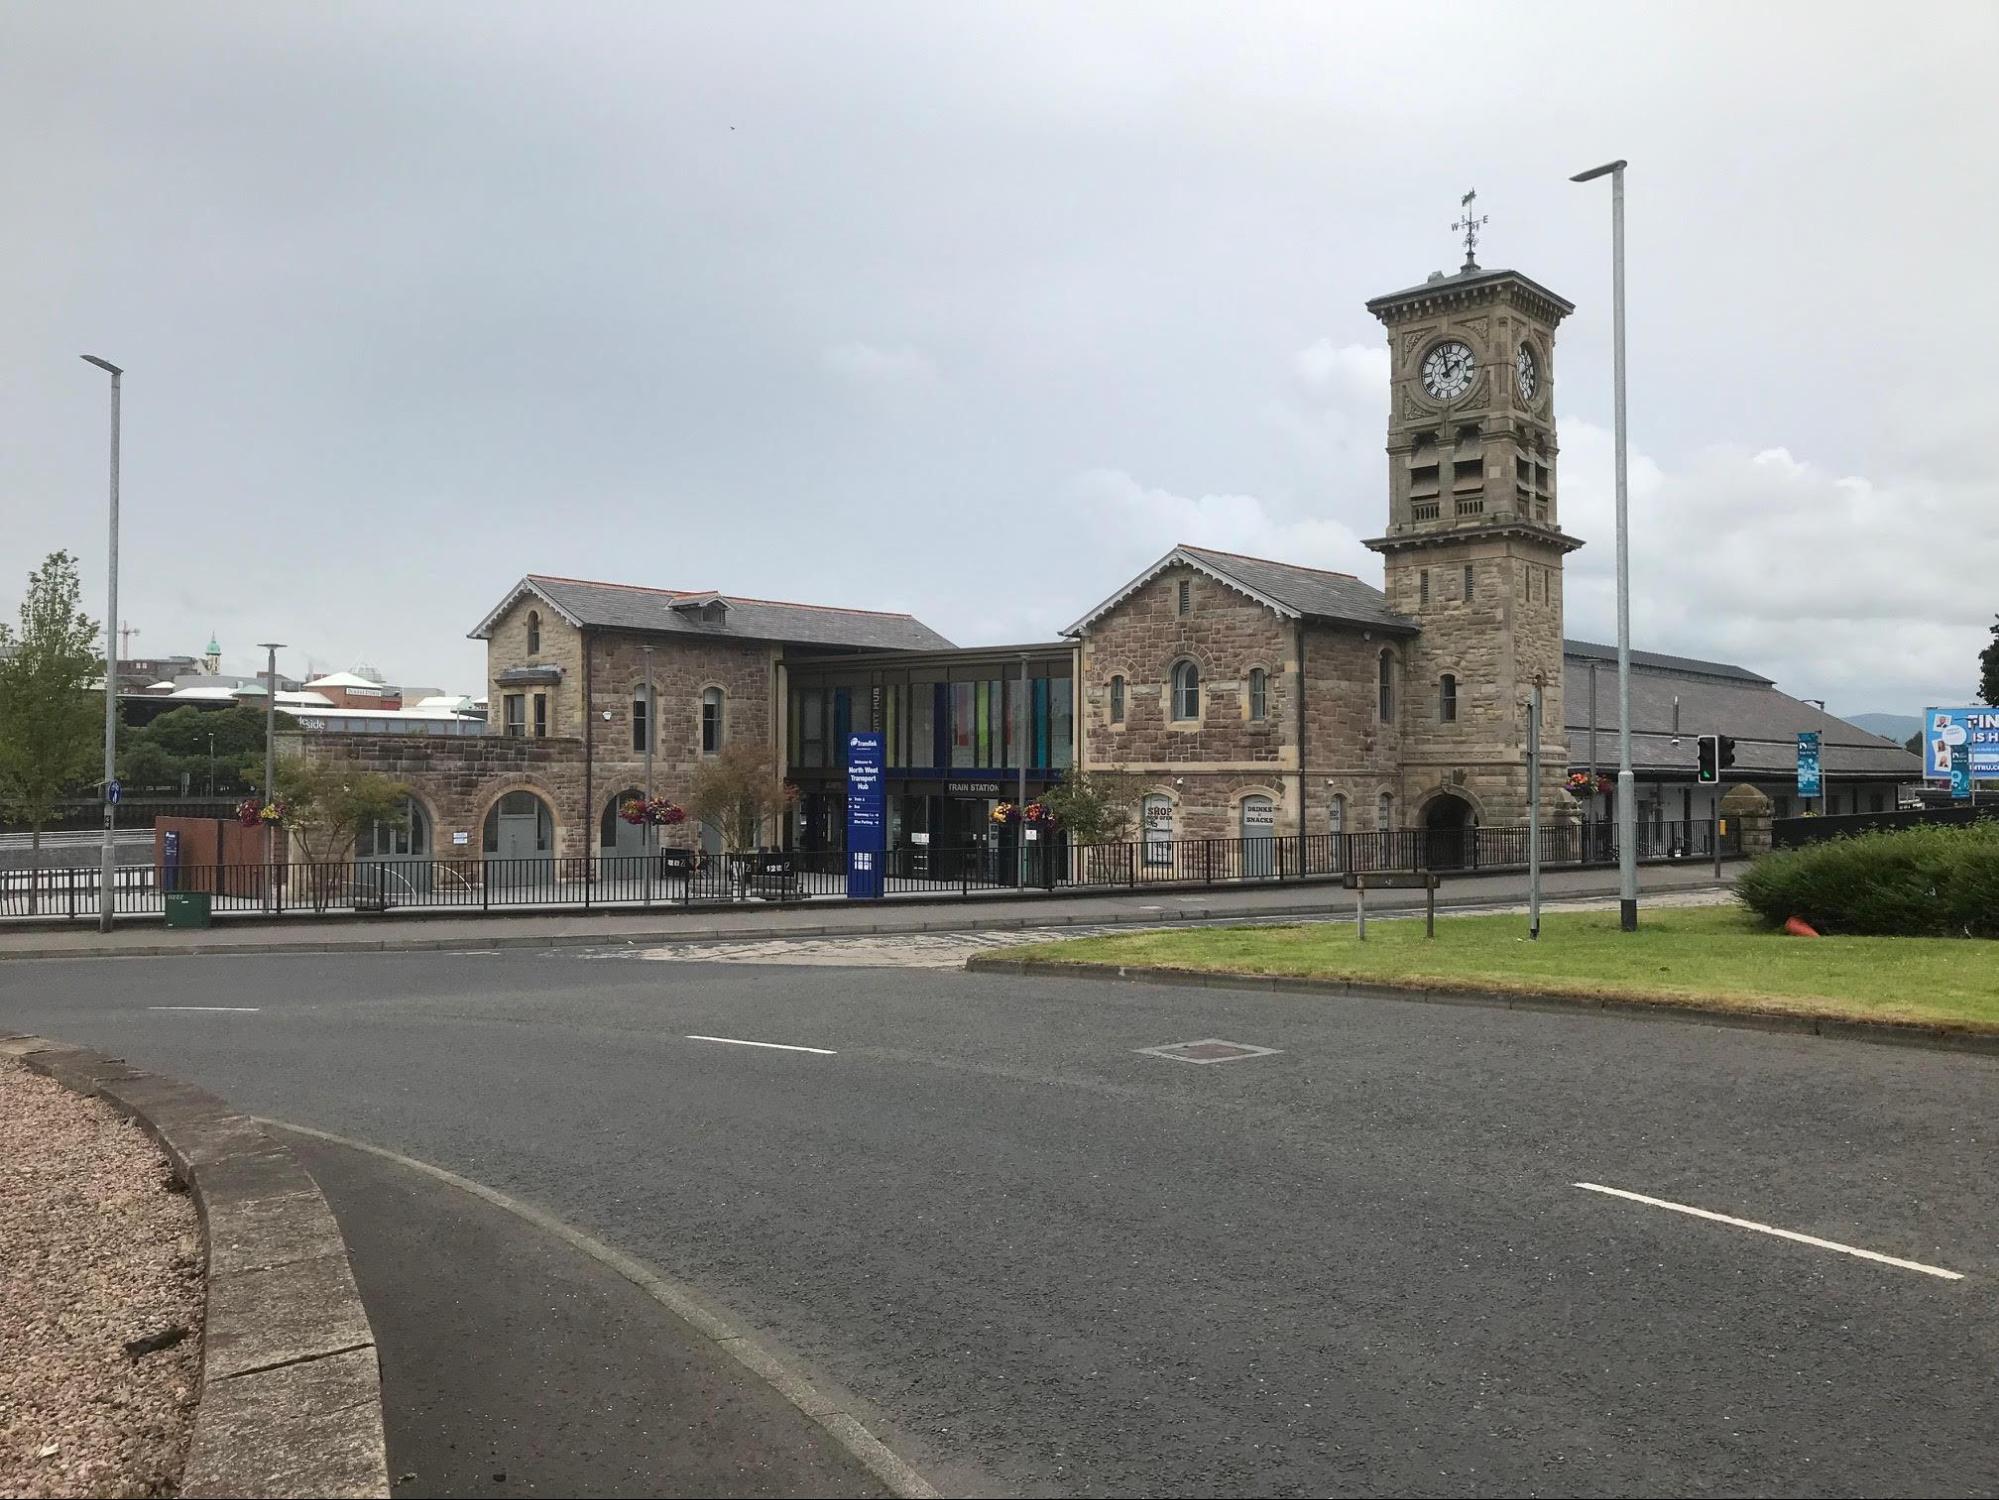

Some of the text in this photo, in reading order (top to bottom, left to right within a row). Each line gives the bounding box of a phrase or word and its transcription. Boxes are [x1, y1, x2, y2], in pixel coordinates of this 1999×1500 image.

[1451, 222, 1460, 232] W
[1967, 714, 1999, 729] FIN
[1988, 732, 1999, 743] H
[949, 783, 1000, 793] TRAIN STATION
[1147, 807, 1173, 816] SHOP
